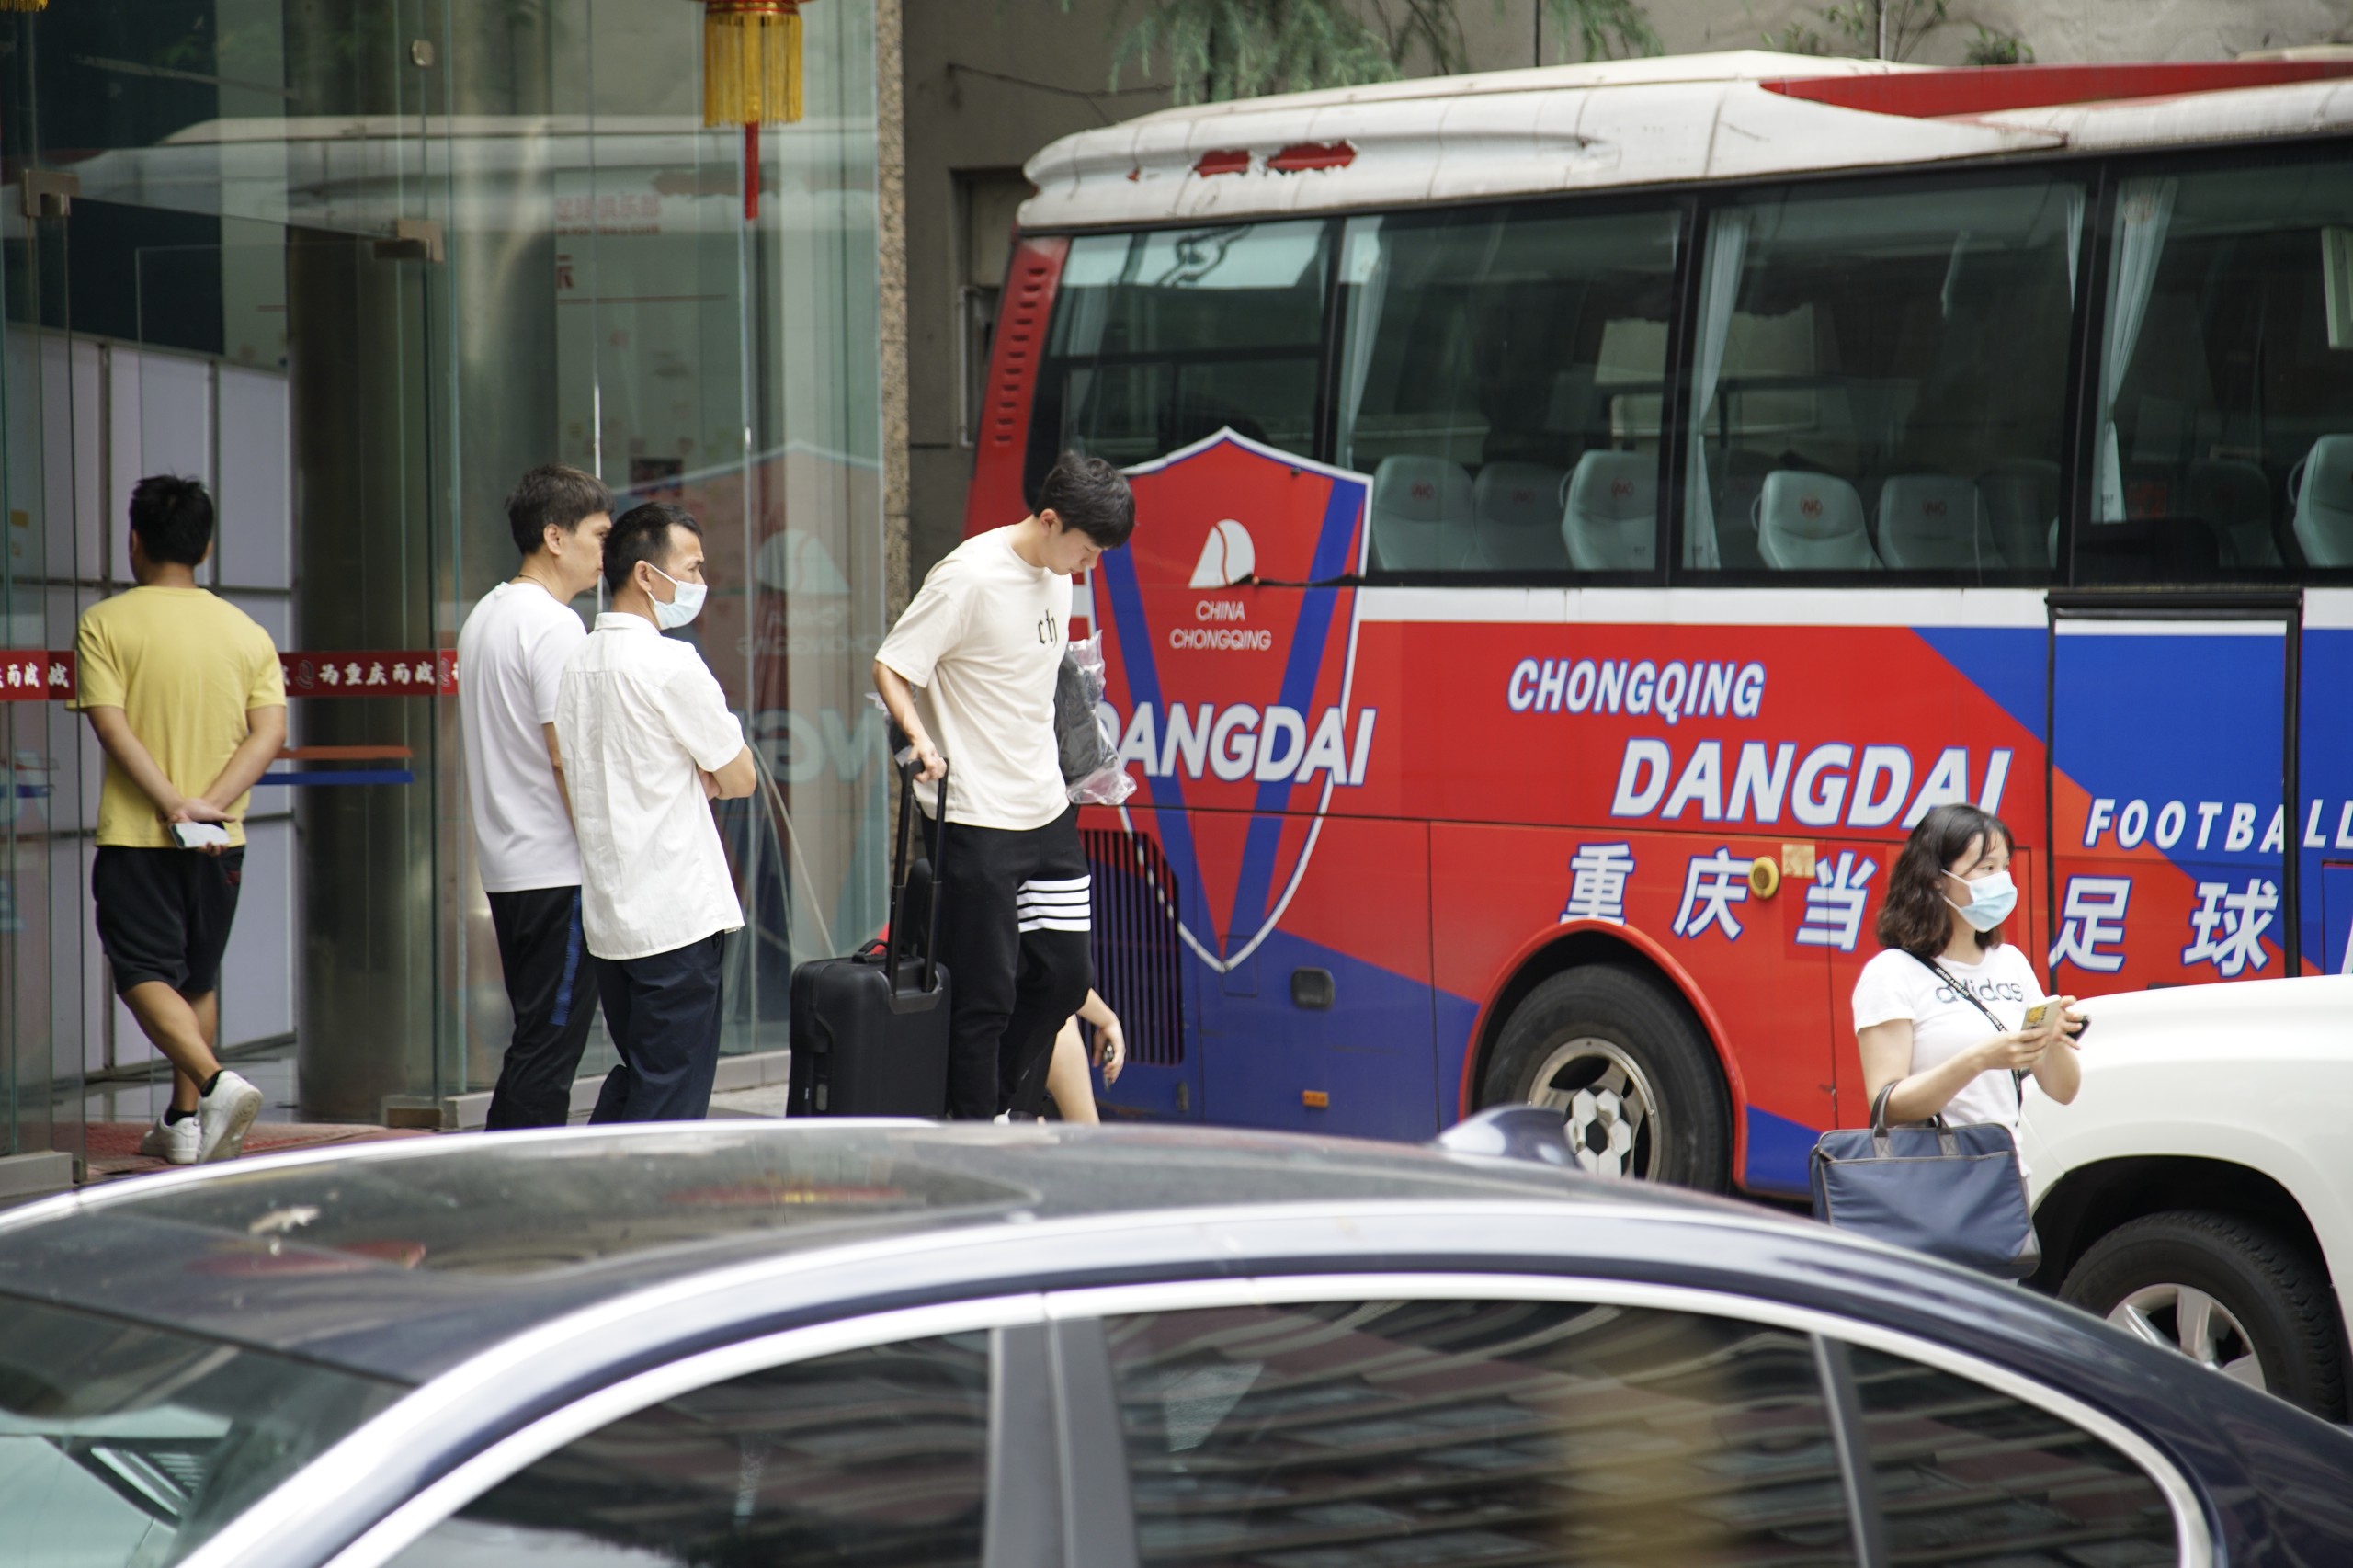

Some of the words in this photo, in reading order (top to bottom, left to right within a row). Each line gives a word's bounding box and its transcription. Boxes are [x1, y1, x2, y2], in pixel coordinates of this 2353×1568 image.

[1195, 600, 1246, 621] CHINA
[1169, 628, 1272, 651] CHONGQING
[0, 661, 40, 688] 而战
[319, 661, 436, 686] 为重庆而战
[1507, 658, 1766, 724] CHONGQING
[1609, 737, 2014, 829] DANGDAI
